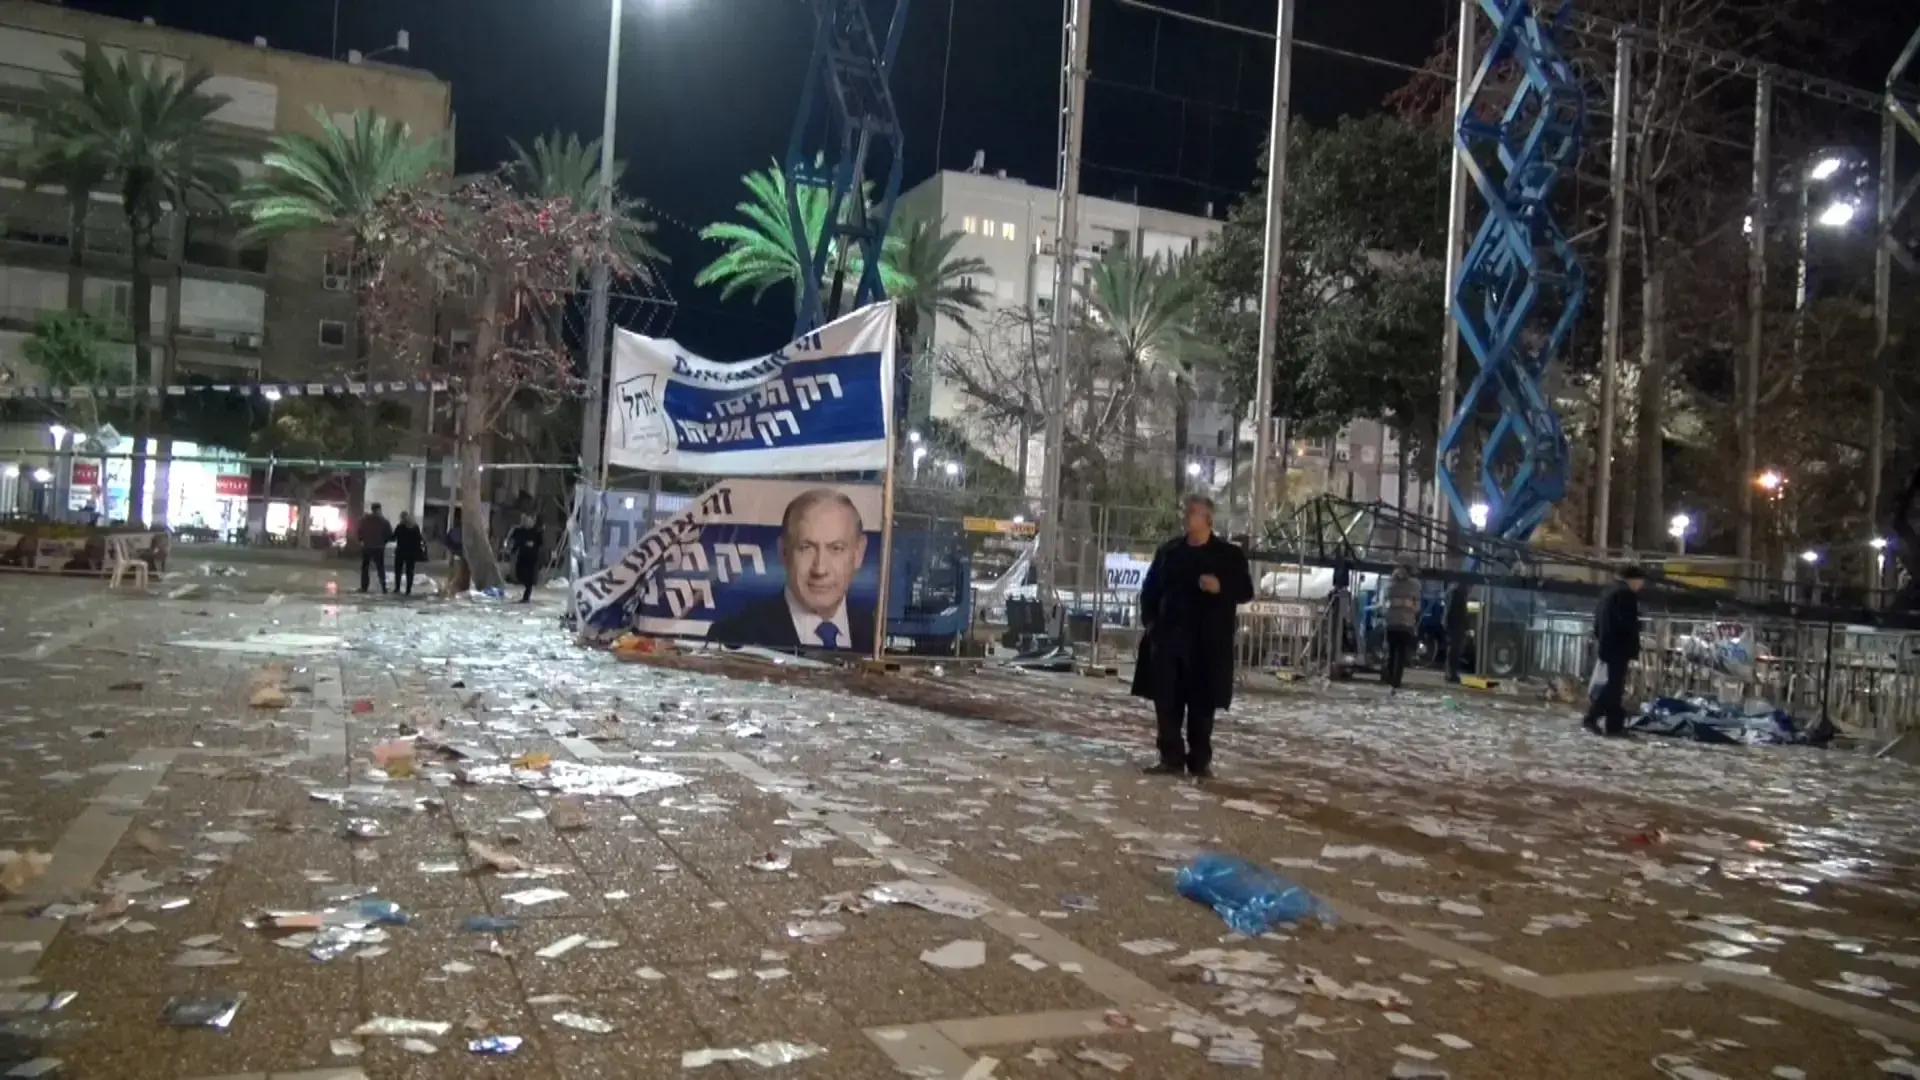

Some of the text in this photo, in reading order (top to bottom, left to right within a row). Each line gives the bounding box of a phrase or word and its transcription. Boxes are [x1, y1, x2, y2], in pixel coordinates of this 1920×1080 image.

[792, 373, 843, 410] רק
[755, 409, 801, 446] רק
[701, 491, 733, 515] זה
[714, 543, 766, 584] רק
[664, 578, 716, 619] רק
